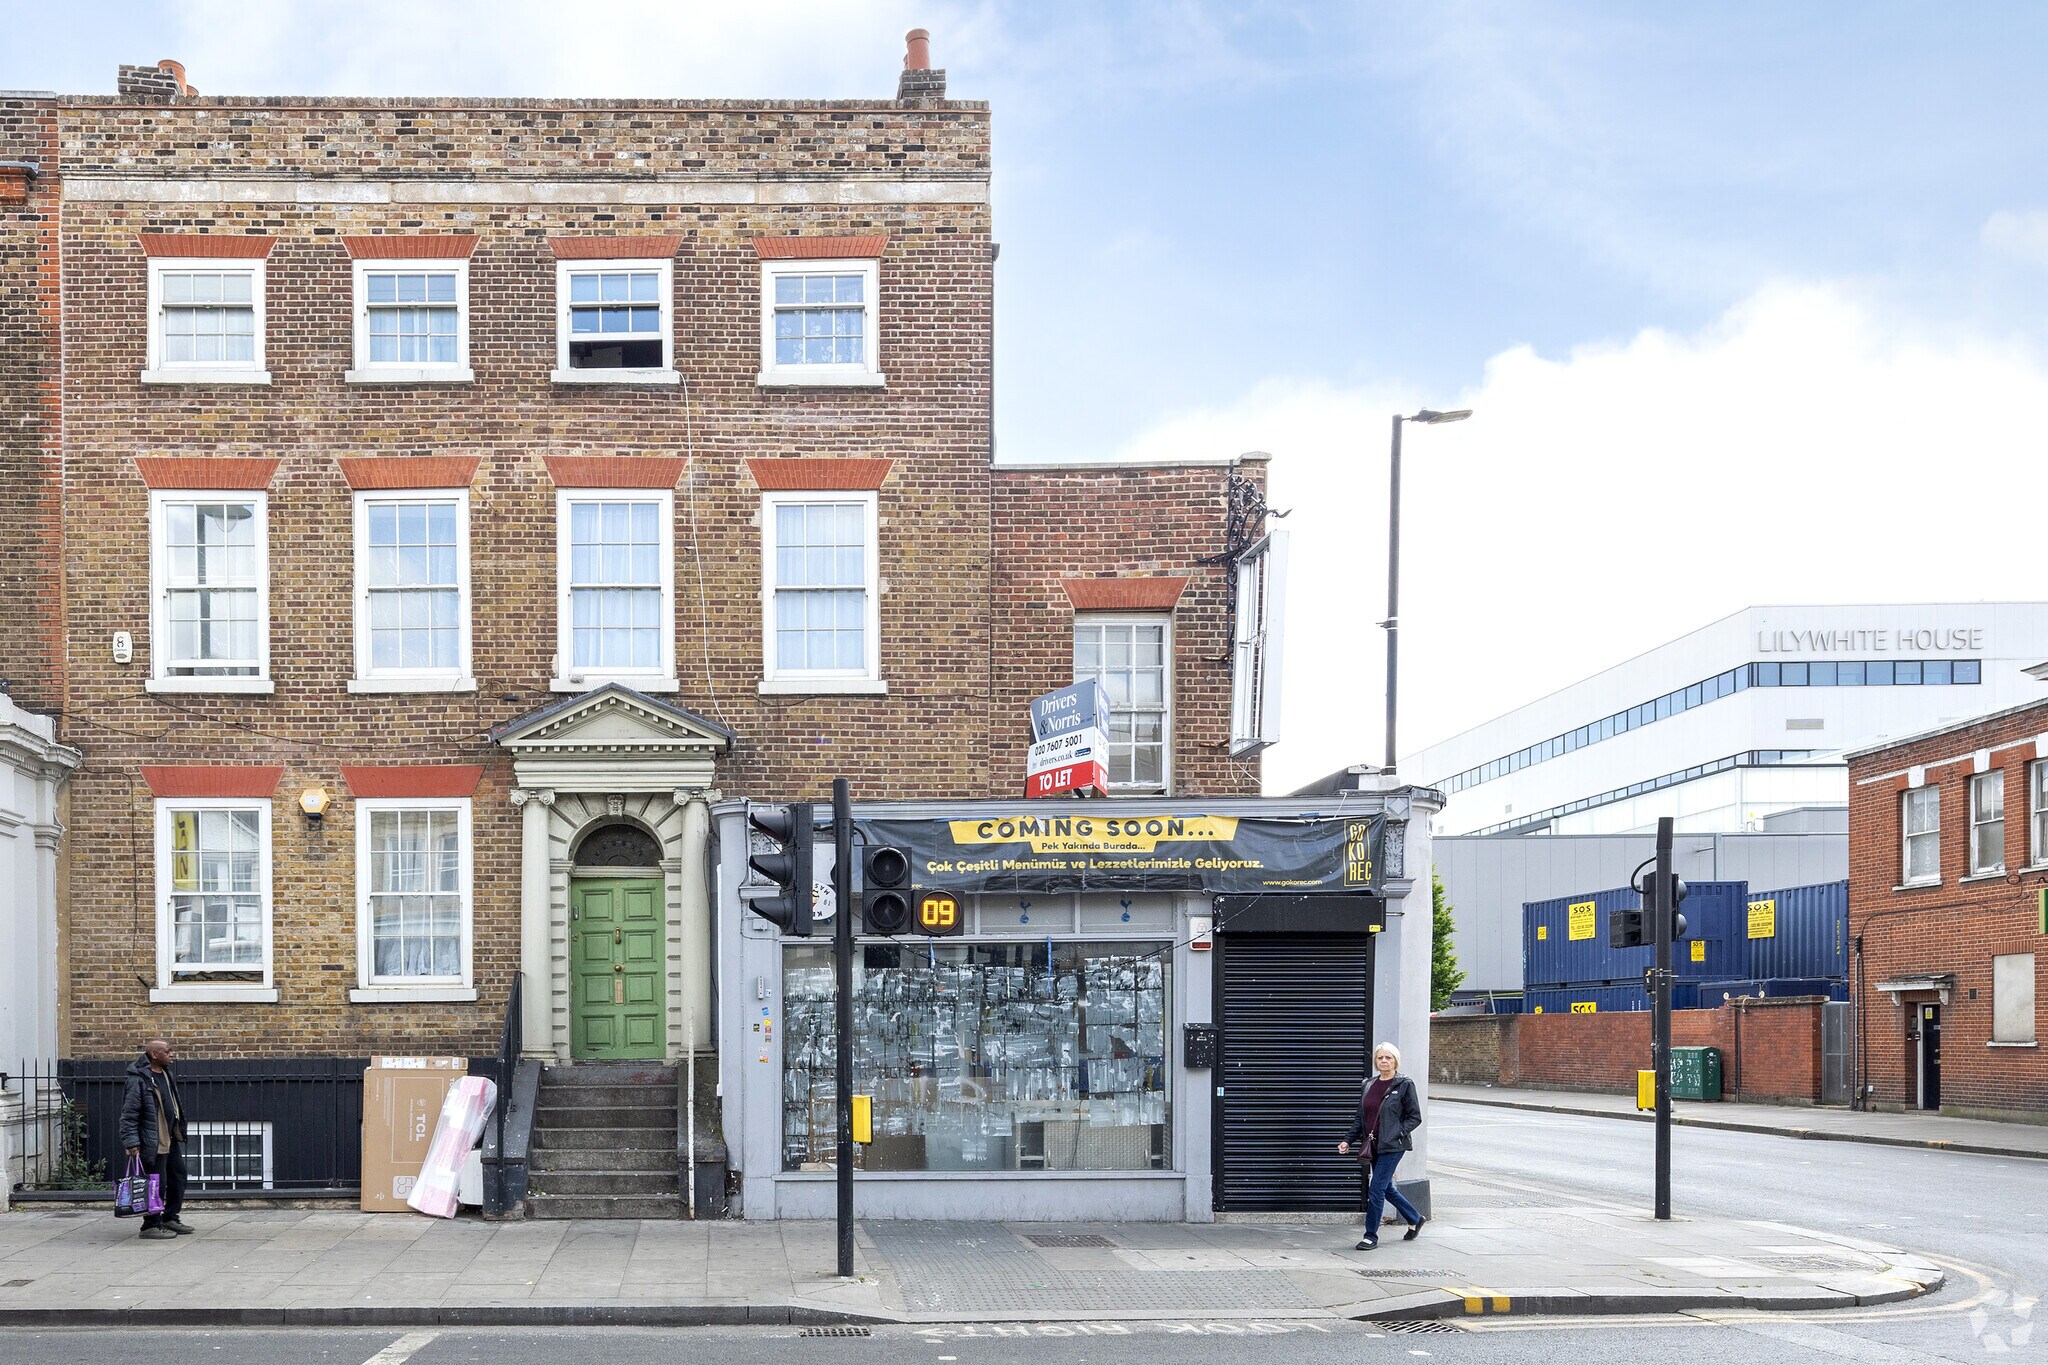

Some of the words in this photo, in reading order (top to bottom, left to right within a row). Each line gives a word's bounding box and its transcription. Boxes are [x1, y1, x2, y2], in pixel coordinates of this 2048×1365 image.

[1758, 629, 1887, 652] LILYWHITE
[1898, 628, 1984, 651] HOUSE
[1040, 693, 1077, 716] Drivers
[1034, 744, 1046, 756] 020
[1046, 739, 1063, 755] 7607
[1064, 734, 1082, 748] 5001
[1040, 750, 1073, 767] drivers.co.uk
[1039, 772, 1053, 791] TO
[1054, 768, 1073, 788] LET
[977, 819, 1093, 839] COMING
[1107, 819, 1214, 837] SOON...
[1349, 823, 1366, 841] GO
[1041, 842, 1059, 850] Pek
[1061, 842, 1100, 850] Yakında
[1103, 842, 1146, 850] Burada...
[1348, 841, 1365, 859] KO
[926, 860, 954, 874] Çok
[956, 859, 999, 874] Çeşitli
[1002, 859, 1067, 870] Menümüz
[1070, 861, 1086, 869] ve
[1089, 857, 1191, 869] Lezzetlerimizle
[1194, 857, 1265, 871] Geliyoruz.
[1348, 861, 1372, 881] REC
[1262, 878, 1323, 887] www.gokorec.com
[922, 899, 955, 925] 09
[415, 1113, 427, 1142] TCL
[397, 1176, 413, 1194] 55
[957, 1324, 1132, 1338] RIGHT
[1154, 1322, 1331, 1335] LOOK
